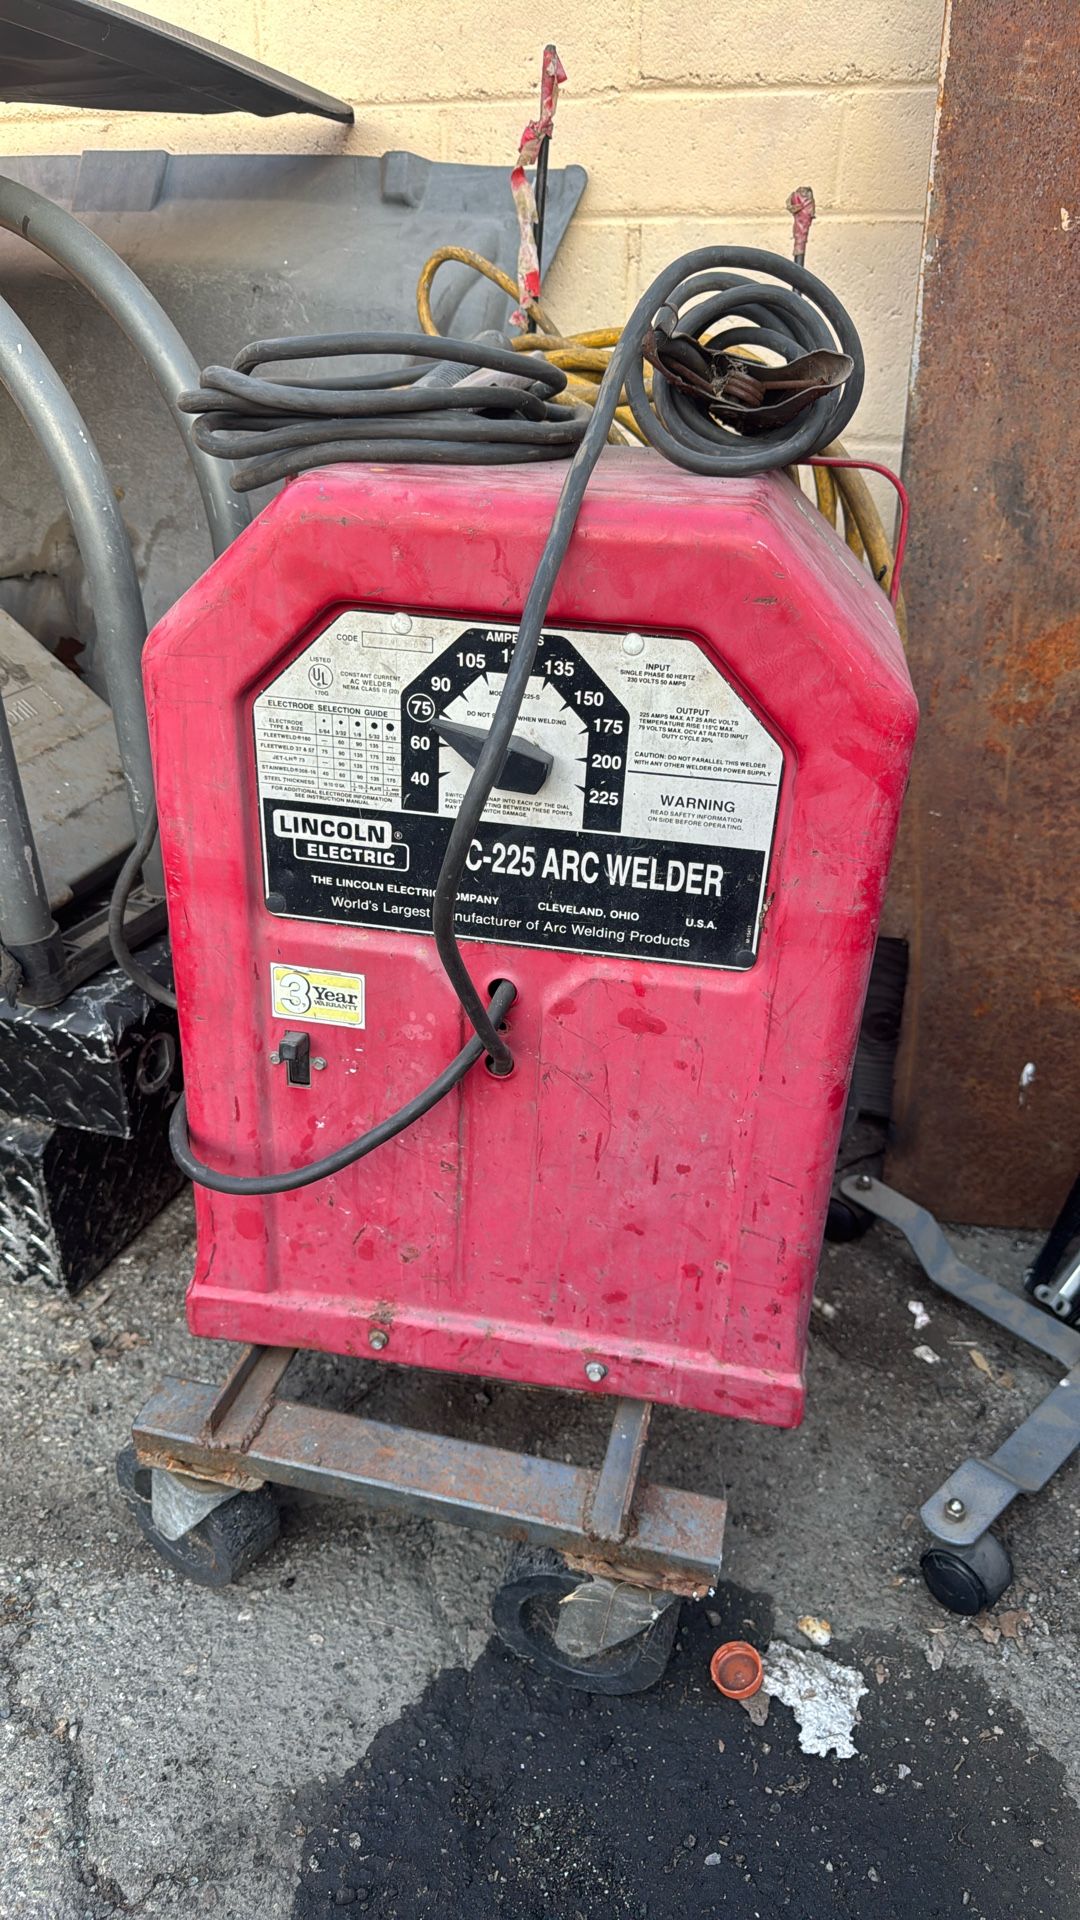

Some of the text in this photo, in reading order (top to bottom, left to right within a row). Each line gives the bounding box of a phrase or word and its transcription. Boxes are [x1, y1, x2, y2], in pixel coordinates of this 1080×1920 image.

[337, 634, 358, 642] CODE
[486, 632, 544, 646] AMPES
[457, 653, 485, 669] 105
[544, 660, 574, 676] 135
[313, 668, 328, 686] UL
[340, 671, 400, 682] CONSTANT CURRENT
[362, 680, 391, 688] WELDER
[431, 677, 450, 691] 90
[574, 691, 604, 706] 150
[268, 700, 388, 718] ELECTRODE SELECTION GUIDE
[411, 701, 431, 716] 75
[676, 707, 710, 716] OUTPUT
[269, 718, 303, 726] ELECTRODE
[594, 719, 623, 734] 175
[640, 718, 684, 727] TEMPERATURE
[410, 736, 430, 750] 60
[592, 755, 621, 770] 200
[634, 751, 666, 759] CAUTION:
[692, 757, 723, 765] PARALLEL
[740, 761, 766, 769] WELDER
[686, 764, 712, 772] WELDER
[723, 767, 746, 775] POWER
[283, 777, 314, 785] THICKNESS
[410, 772, 429, 786] 40
[283, 786, 317, 795] ADDITIONAL
[319, 790, 352, 798] ELECTRODE
[354, 793, 392, 803] INFORMATION
[307, 794, 345, 803] INSTRUCTION
[589, 791, 618, 806] 225
[661, 794, 736, 813] WARNING
[670, 811, 696, 819] SAFETY
[697, 813, 743, 823] INFORMATION
[675, 818, 701, 826] BEFORE
[703, 821, 744, 831] OPERATING.
[280, 815, 384, 843] LINCOLN
[307, 844, 395, 866] ELECTRIC
[466, 838, 724, 897] C-225 ARC WELDER
[311, 875, 333, 886] THE
[336, 878, 384, 892] LINCOLN
[456, 892, 499, 905] MPANY
[538, 902, 606, 918] CLEVELAND,
[610, 910, 640, 921] OHIO
[685, 918, 717, 930] U.S.A.
[331, 896, 690, 948] World's Largest nufacturer of Arc Welding Products
[280, 972, 311, 1014] 3
[312, 986, 357, 1004] Year
[314, 1000, 358, 1011] WARRANTY
